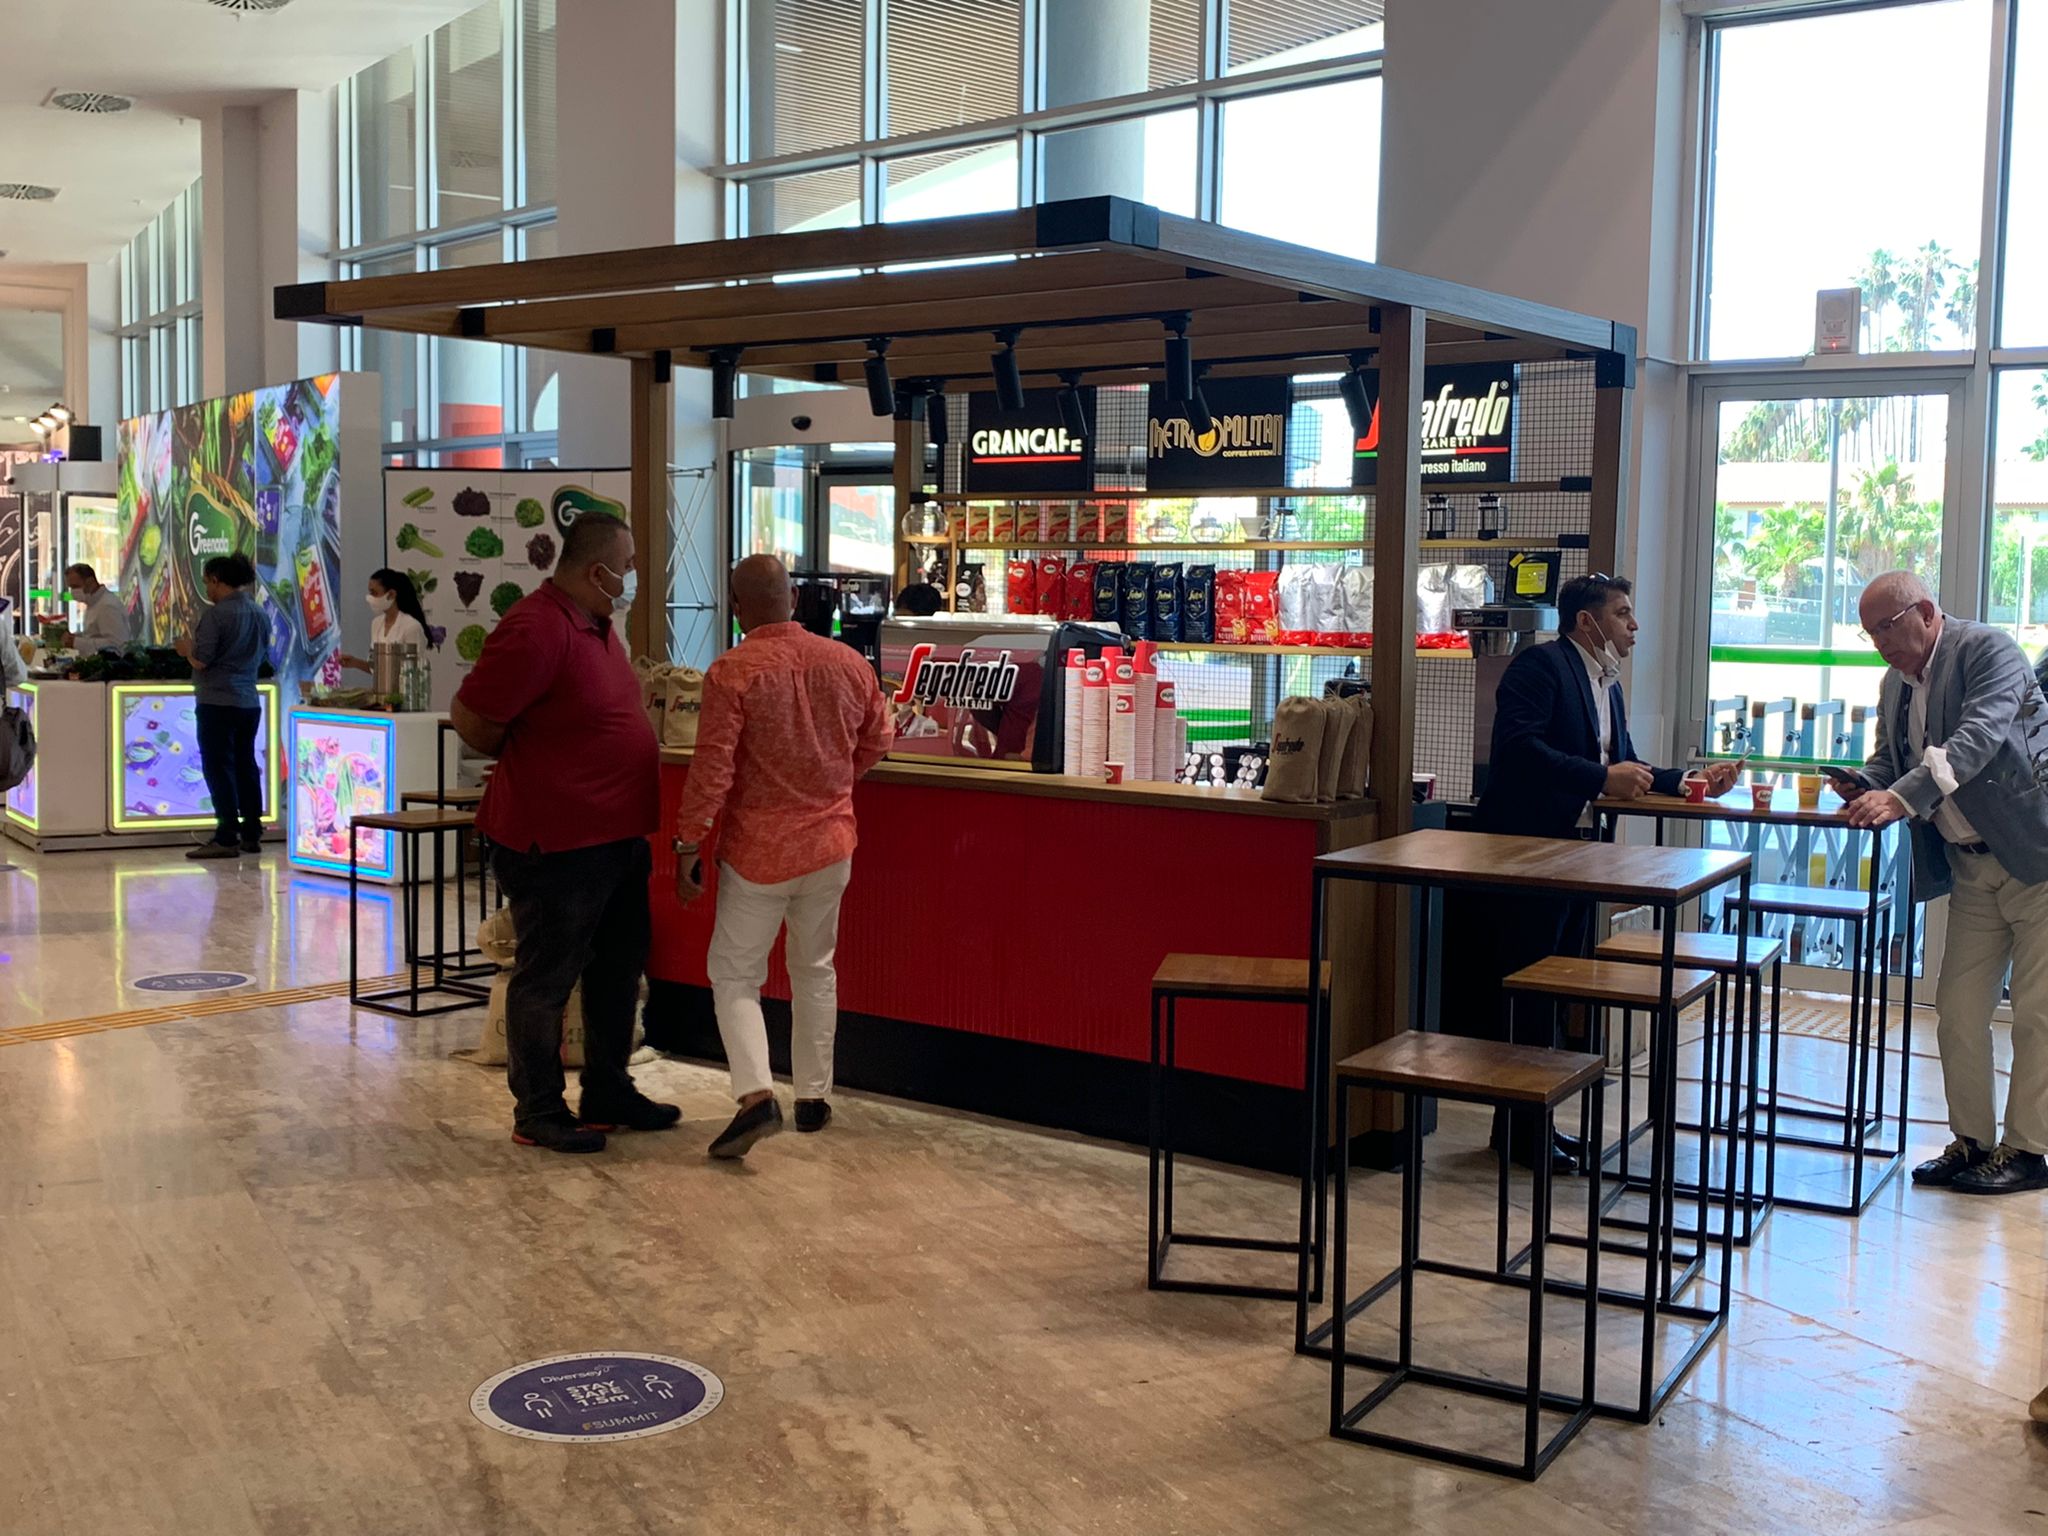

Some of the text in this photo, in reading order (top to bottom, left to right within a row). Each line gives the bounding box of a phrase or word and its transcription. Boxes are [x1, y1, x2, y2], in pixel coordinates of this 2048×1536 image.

[1422, 436, 1477, 448] ZANETTI
[1451, 459, 1487, 474] italiano
[893, 643, 1020, 707] Segafredo
[945, 698, 992, 710] ZANETTI
[540, 1370, 602, 1384] Diversey
[566, 1380, 614, 1393] STAY
[570, 1387, 625, 1401] SAFE
[576, 1394, 630, 1407] 1.5m
